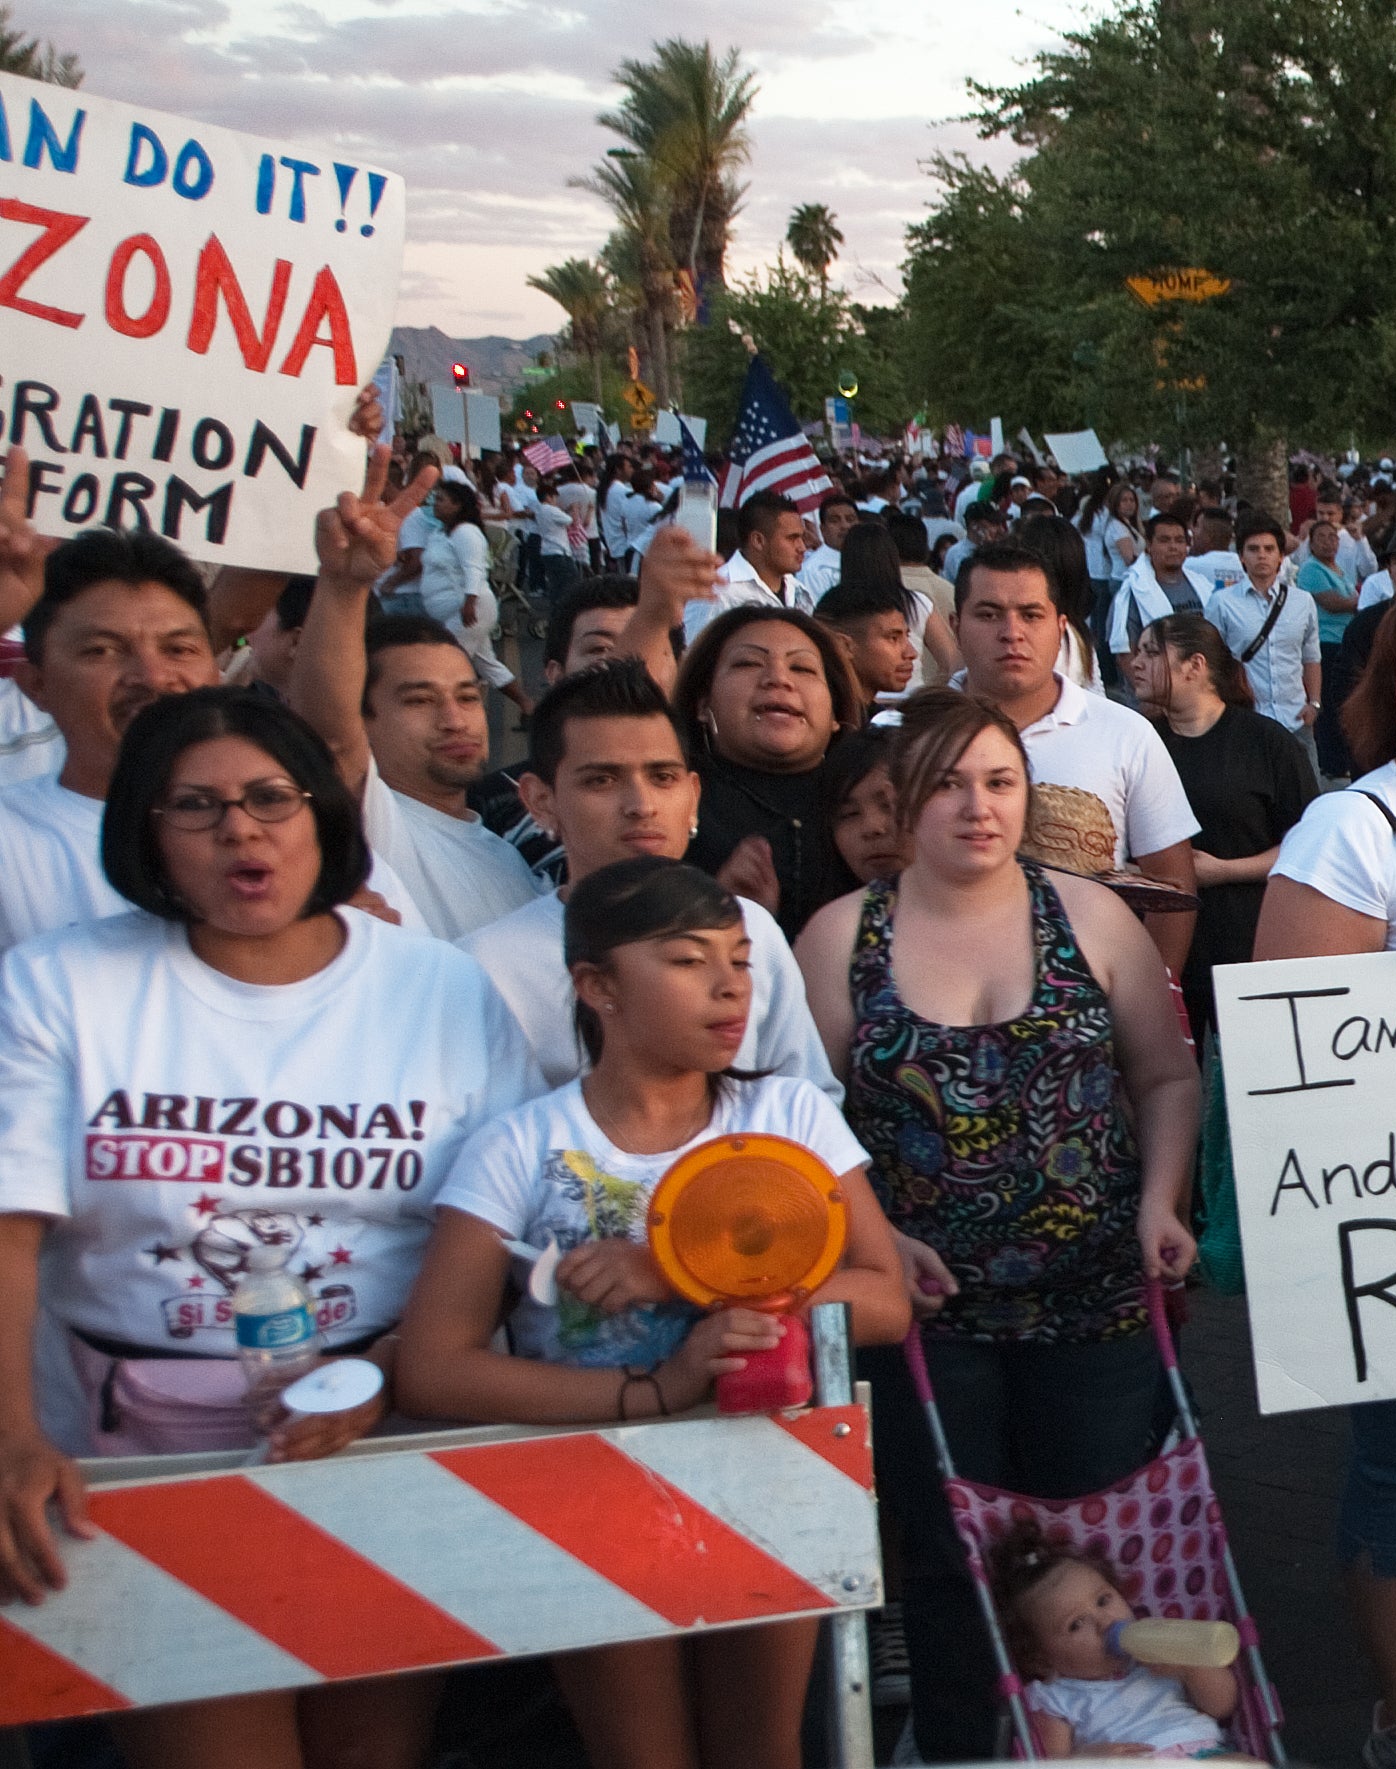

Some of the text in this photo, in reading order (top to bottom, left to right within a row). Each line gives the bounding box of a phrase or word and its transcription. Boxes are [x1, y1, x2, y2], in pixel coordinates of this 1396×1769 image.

[123, 122, 214, 201] DO
[256, 154, 388, 238] IT!!
[0, 381, 317, 489] RATION
[0, 455, 235, 545] FORM
[1239, 987, 1355, 1096] I
[88, 1089, 426, 1141] ARIZONA!
[90, 1139, 424, 1191] STOP SB1070
[215, 1301, 234, 1323] S
